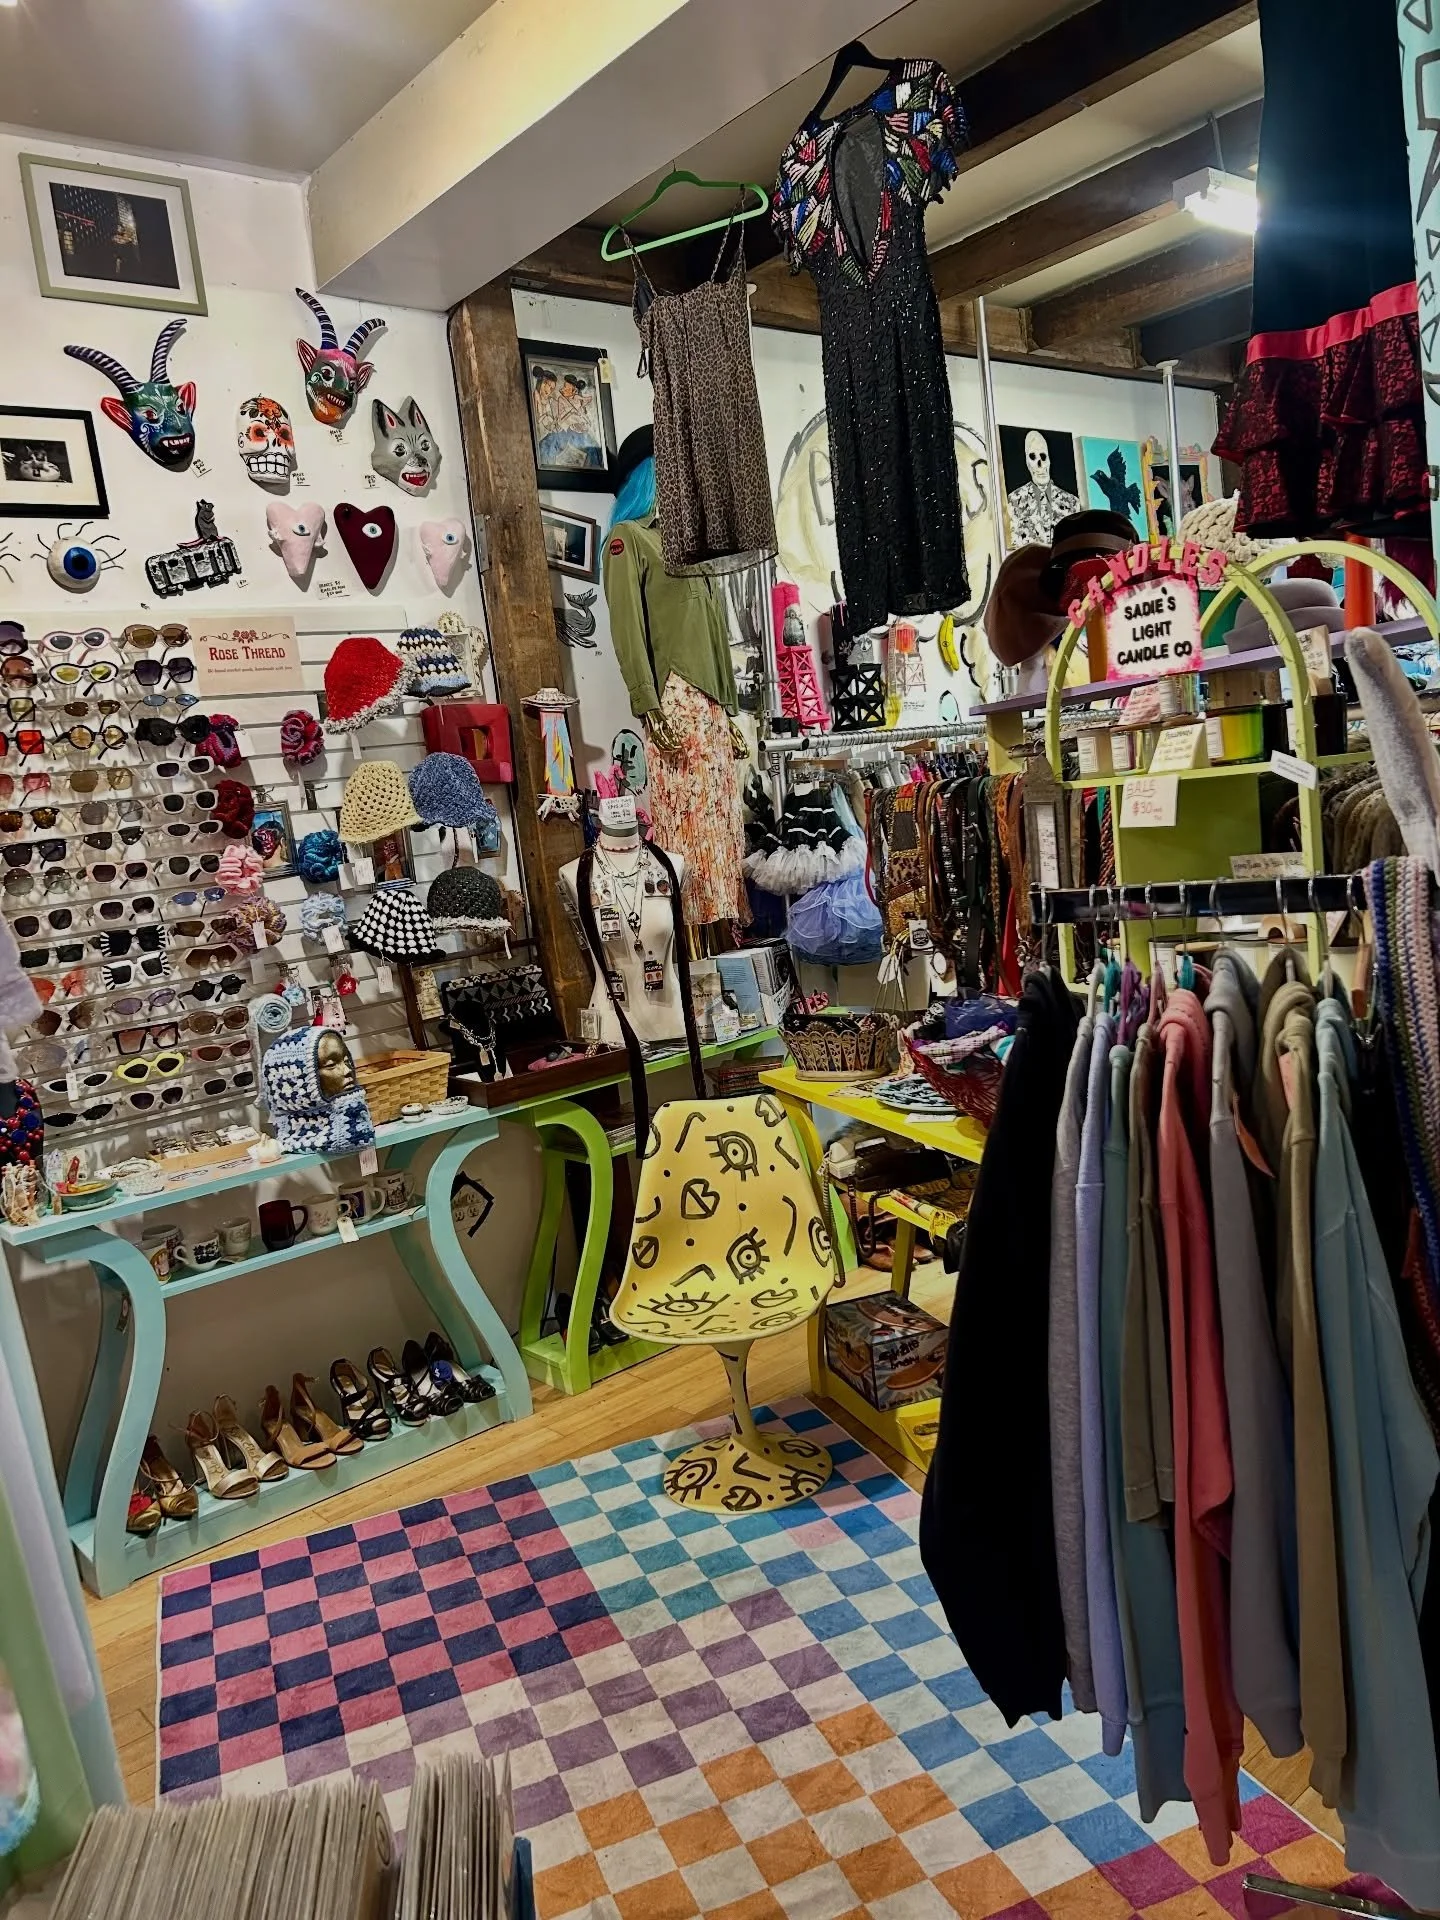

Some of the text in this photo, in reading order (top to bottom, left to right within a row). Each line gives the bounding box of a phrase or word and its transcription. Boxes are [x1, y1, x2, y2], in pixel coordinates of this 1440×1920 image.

[1067, 535, 1228, 629] CANDLES
[1124, 586, 1176, 620] SADIE'S
[1132, 620, 1172, 641] LIGHT
[208, 646, 285, 660] ROSE THREAD
[1117, 640, 1193, 665] CANDLE CO
